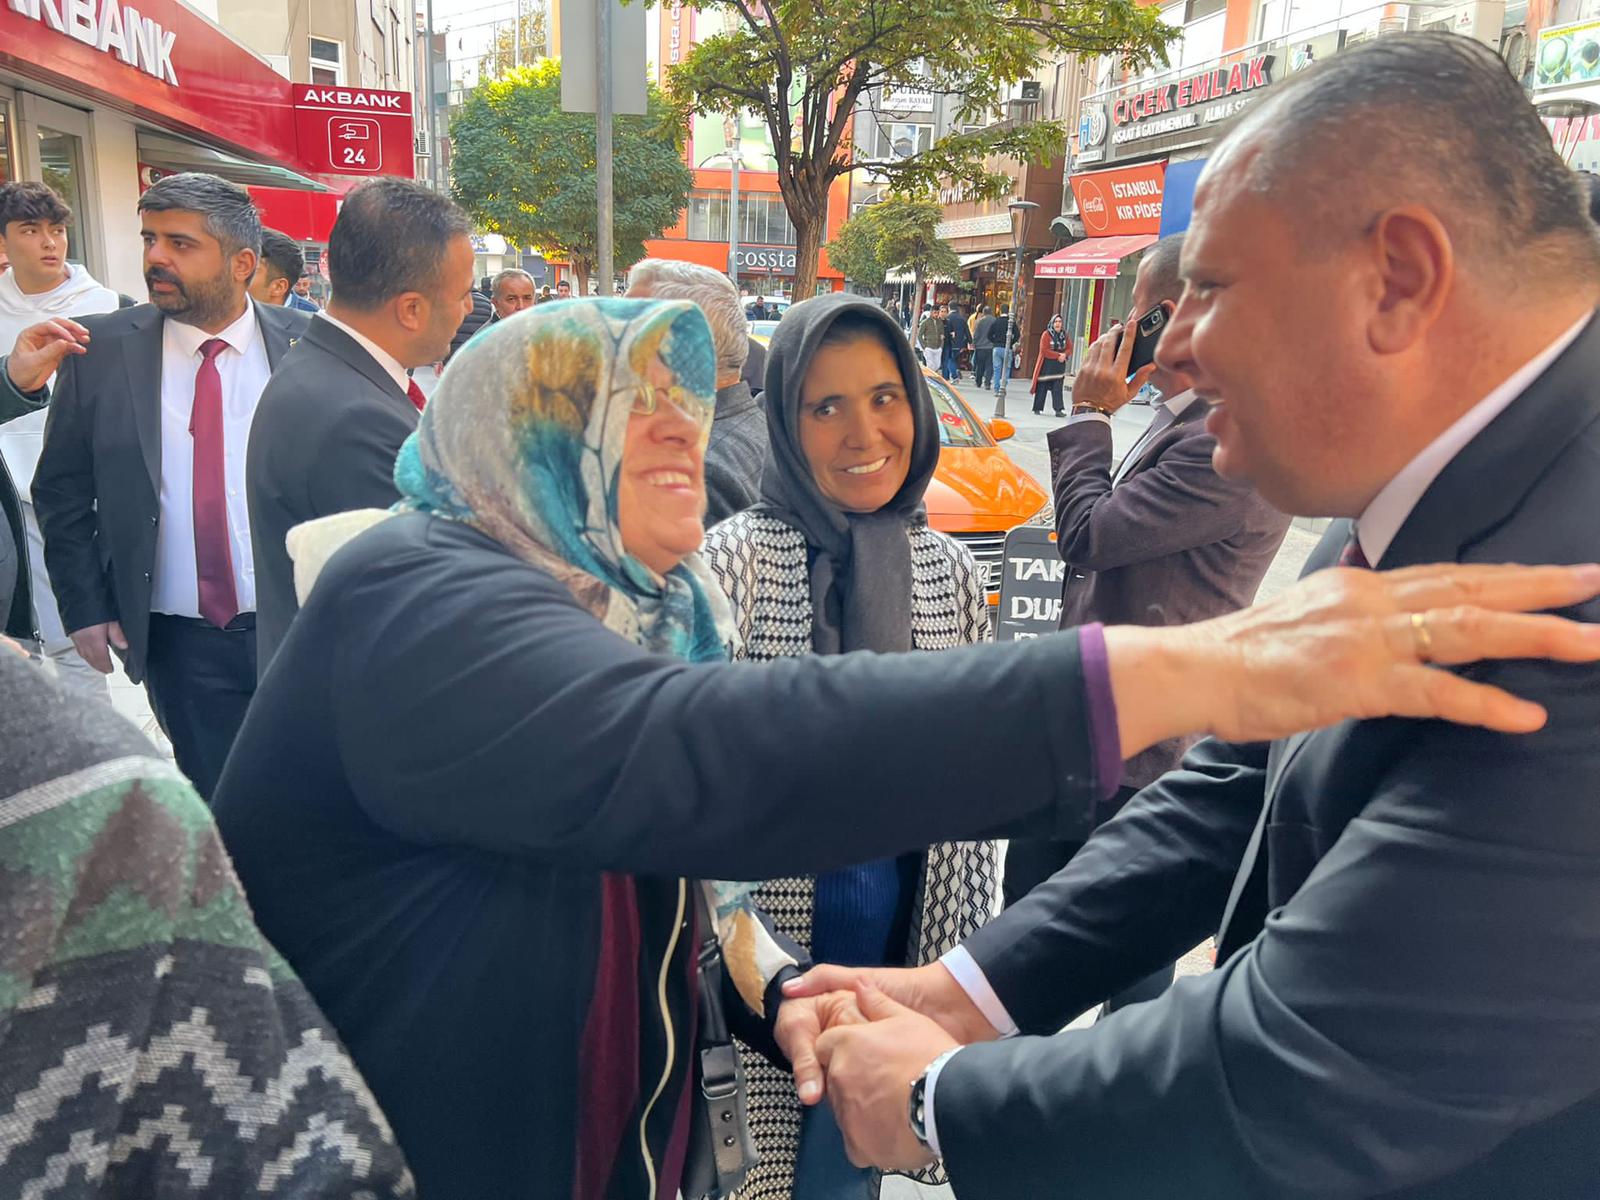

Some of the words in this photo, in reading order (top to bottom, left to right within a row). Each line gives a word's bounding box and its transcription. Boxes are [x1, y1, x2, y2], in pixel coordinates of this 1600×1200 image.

[1177, 55, 1268, 108] EMLAK
[304, 89, 401, 108] AKBANK
[343, 148, 366, 164] 24
[1111, 179, 1162, 198] İSTANBUL
[1116, 205, 1134, 220] KIR
[736, 249, 797, 268] cossta
